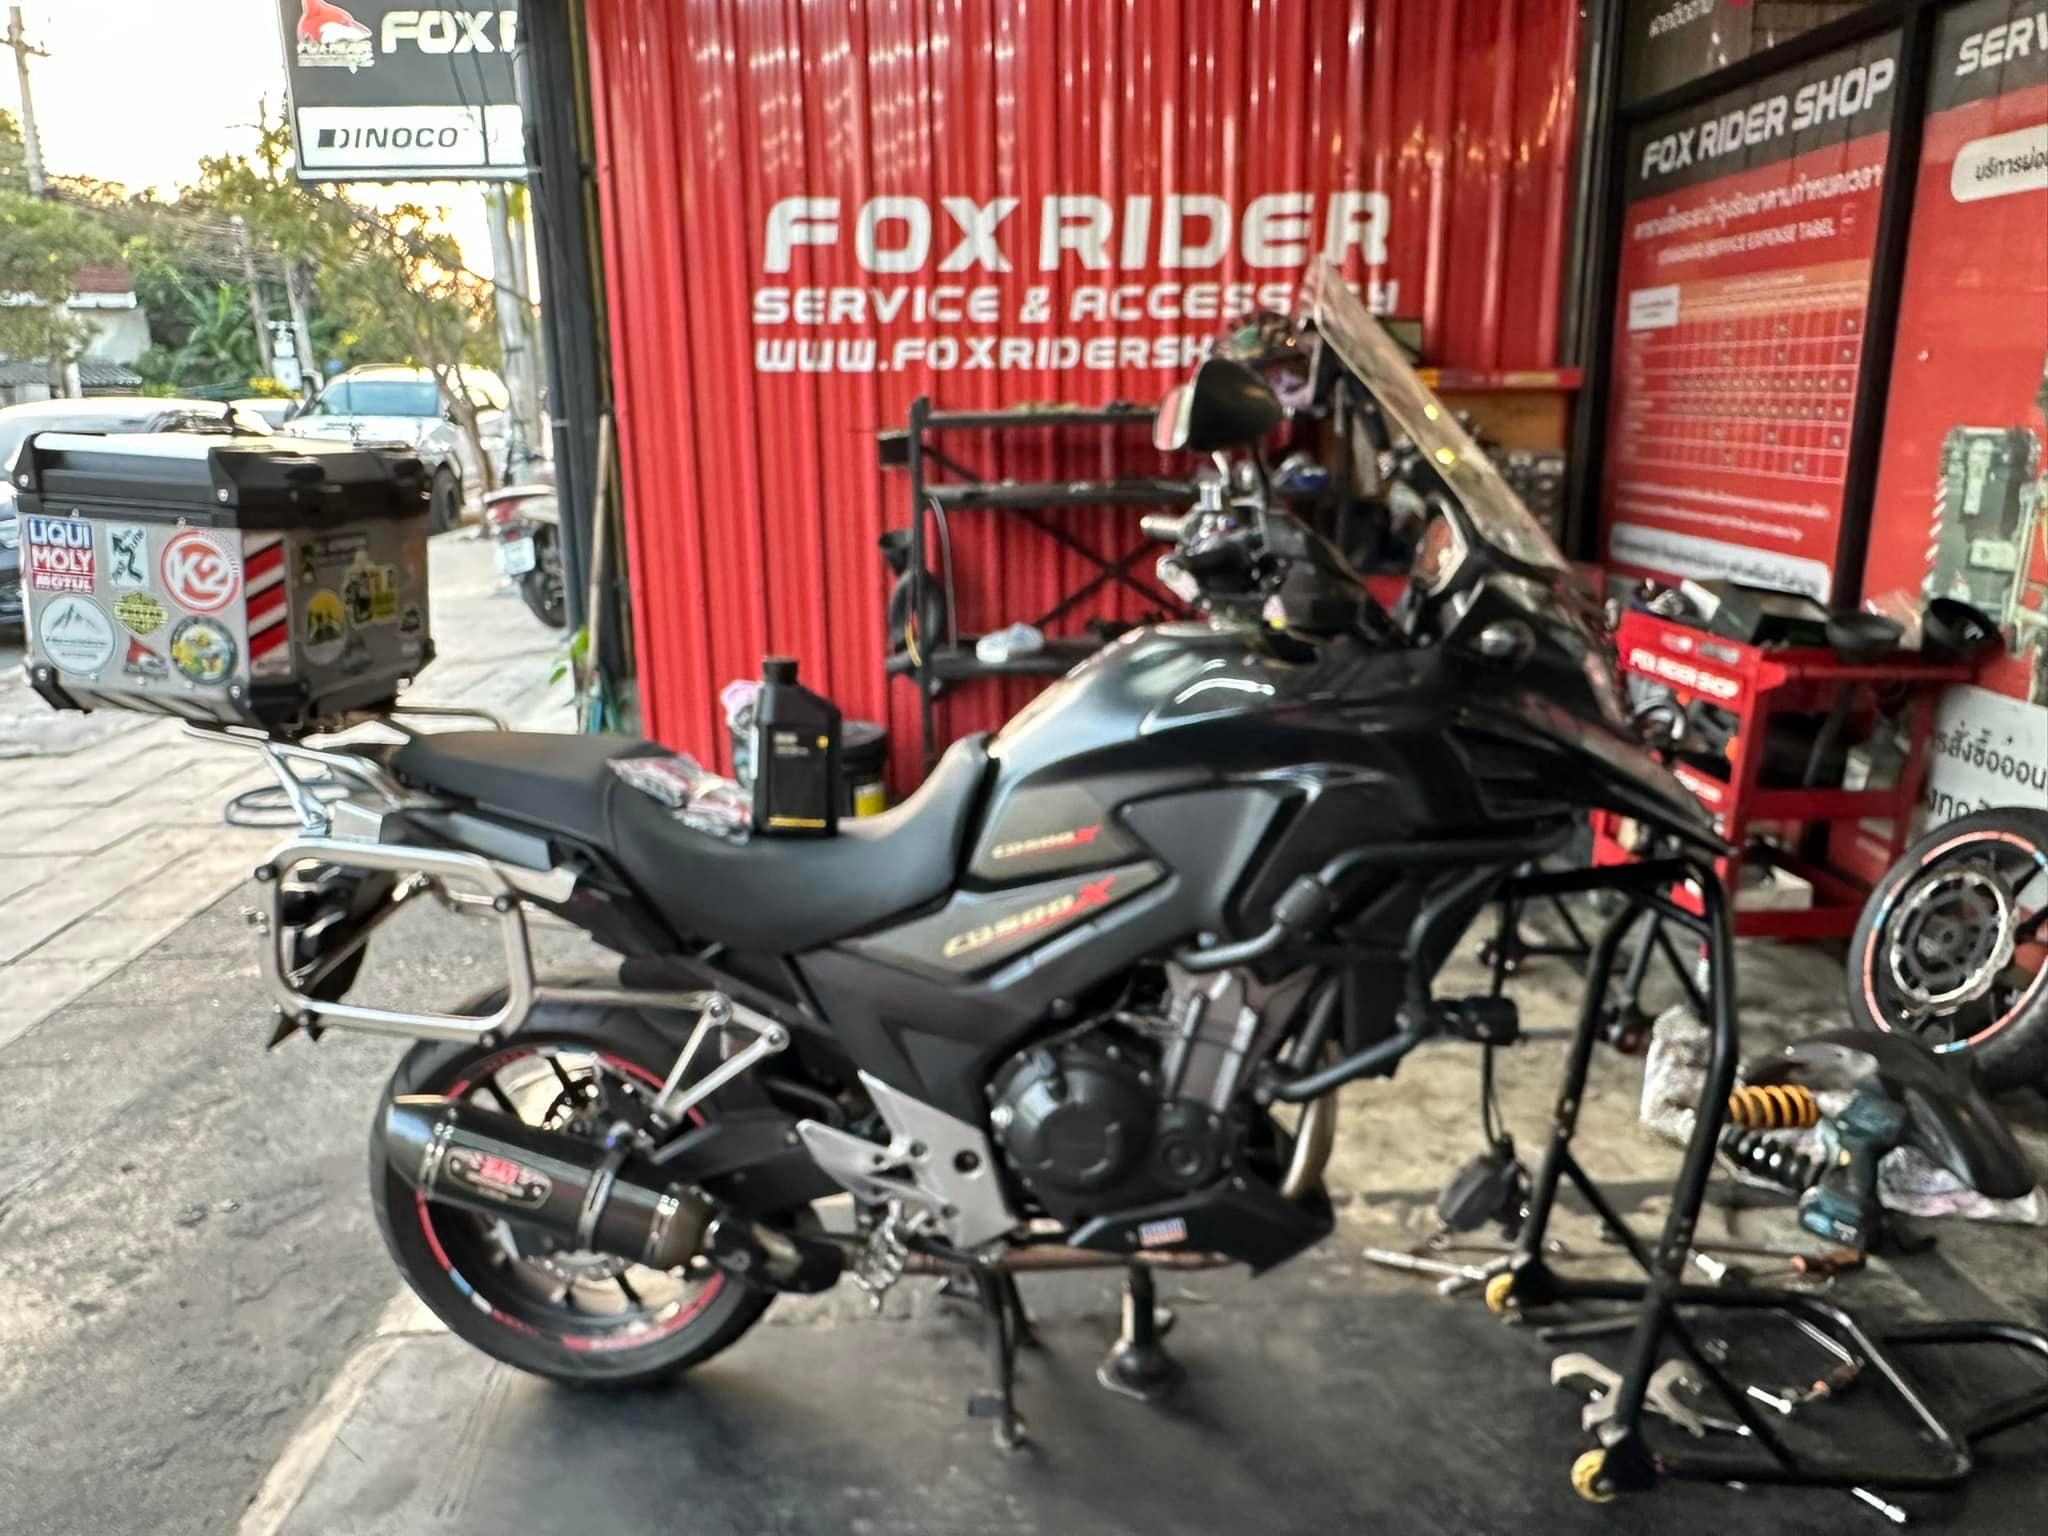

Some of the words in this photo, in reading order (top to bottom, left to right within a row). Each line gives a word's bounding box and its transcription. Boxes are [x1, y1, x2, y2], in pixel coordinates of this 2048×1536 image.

[381, 10, 495, 54] FOX
[1641, 128, 1697, 180] FOX
[1697, 95, 1788, 161] RIDER
[1791, 57, 1895, 131] SHOP
[763, 195, 1020, 274] FOX
[1039, 192, 1391, 272] RIDER
[752, 284, 1000, 325] SERVICE
[1019, 285, 1051, 324] &
[1070, 279, 1399, 323] ACCESSY
[31, 545, 92, 574] MOLY
